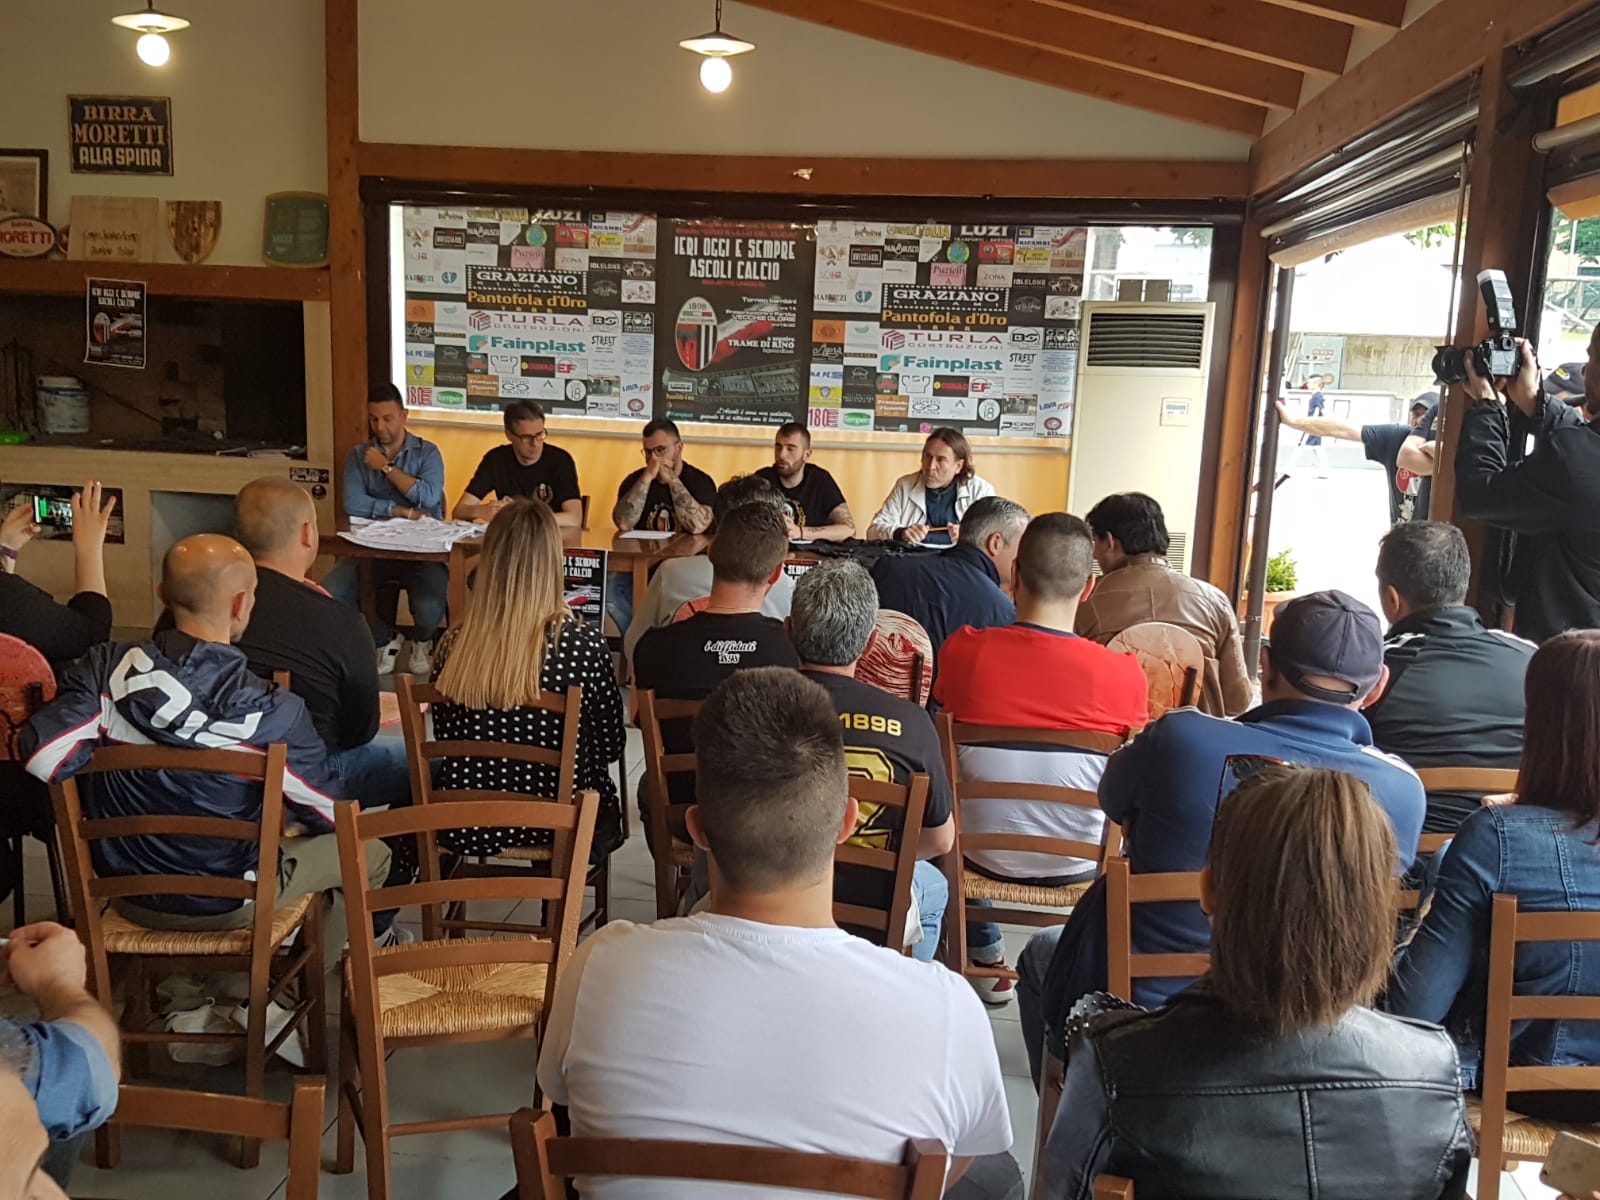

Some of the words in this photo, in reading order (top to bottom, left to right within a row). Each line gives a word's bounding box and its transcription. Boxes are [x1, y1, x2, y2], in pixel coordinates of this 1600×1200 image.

[83, 105, 155, 121] BIRRA
[74, 123, 165, 145] MORETTI
[80, 146, 113, 165] ALLA
[115, 148, 162, 167] SPINA
[961, 225, 1008, 237] LUZI
[674, 236, 698, 256] IERI
[703, 238, 730, 257] OGGI
[735, 239, 742, 257] E
[748, 240, 796, 259] SEMPRE
[476, 271, 578, 285] GRAZIANO
[689, 259, 731, 278] ASCOLI
[737, 262, 780, 280] CALCIO
[467, 291, 543, 306] Pantofola
[547, 294, 588, 308] d'Oro
[893, 289, 1000, 302] GRAZIANO
[495, 313, 583, 327] TURLA
[882, 309, 961, 324] Pantofola
[965, 312, 1008, 326] d'Oro
[491, 336, 586, 354] Fainplast
[728, 339, 759, 348] TRAME
[772, 340, 795, 349] RINO
[908, 332, 1002, 344] TURLA
[903, 355, 1003, 373] Fainplast
[808, 409, 829, 427] 180
[839, 713, 902, 736] 1898
